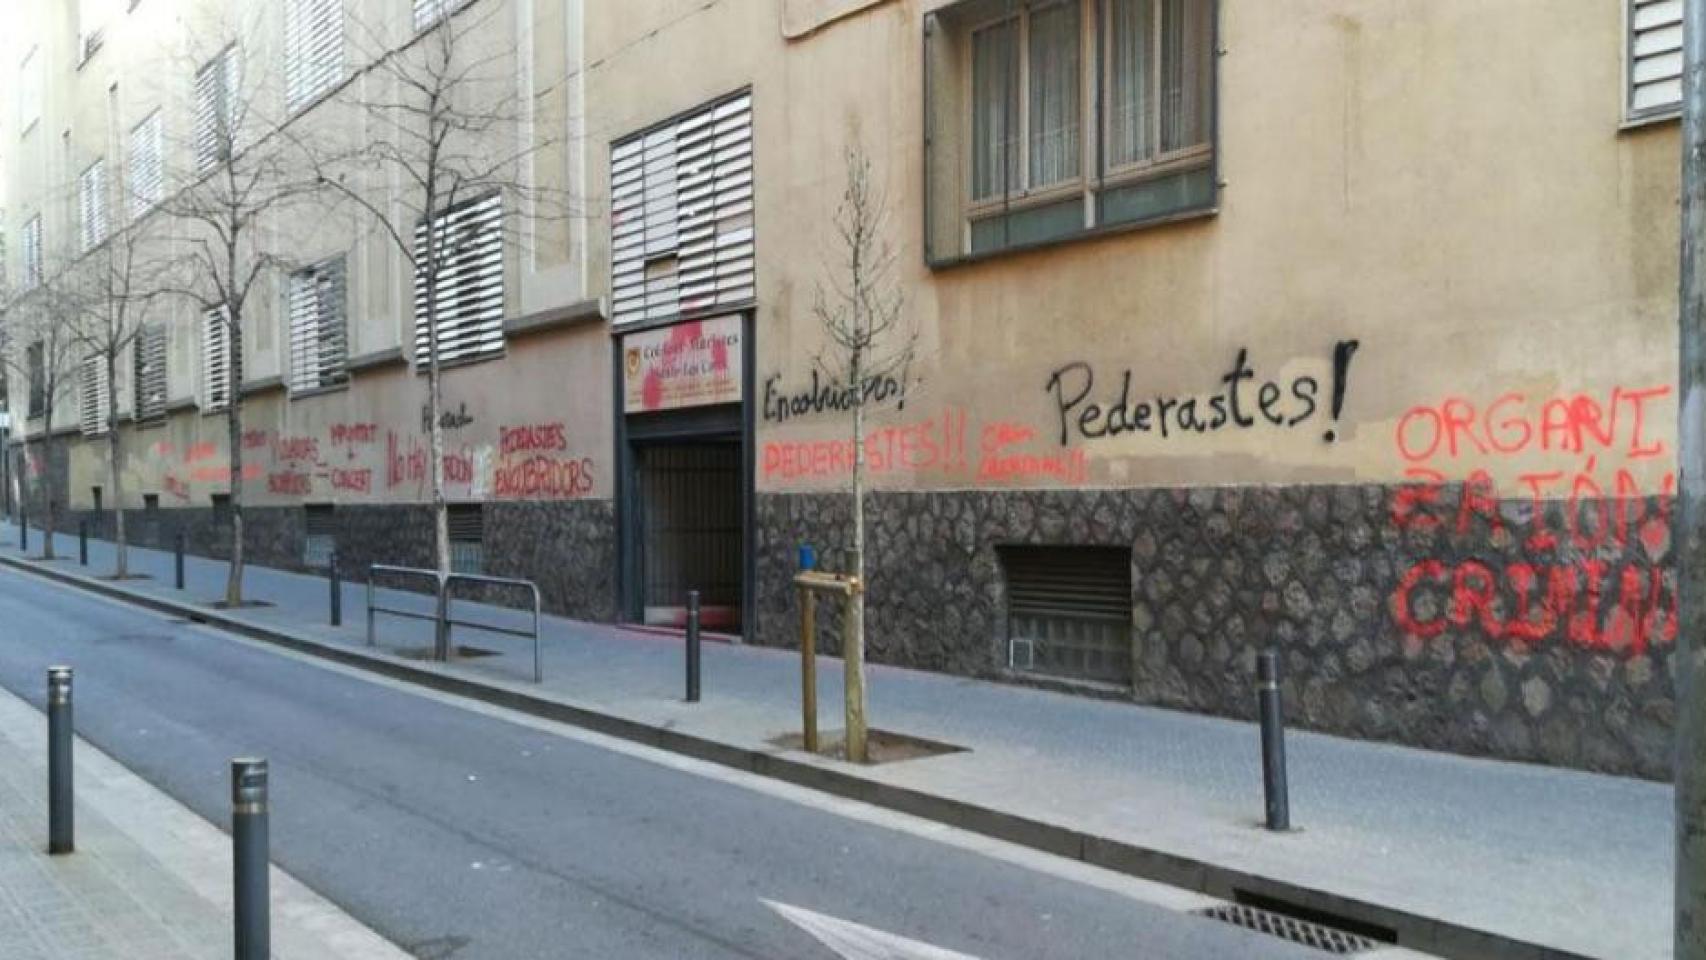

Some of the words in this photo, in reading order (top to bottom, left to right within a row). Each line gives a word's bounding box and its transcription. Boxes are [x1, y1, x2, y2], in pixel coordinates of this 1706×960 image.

[1046, 339, 1359, 447] Pederastes!
[1396, 385, 1671, 462] ORGANI
[760, 406, 968, 482] PEDERASTES!!
